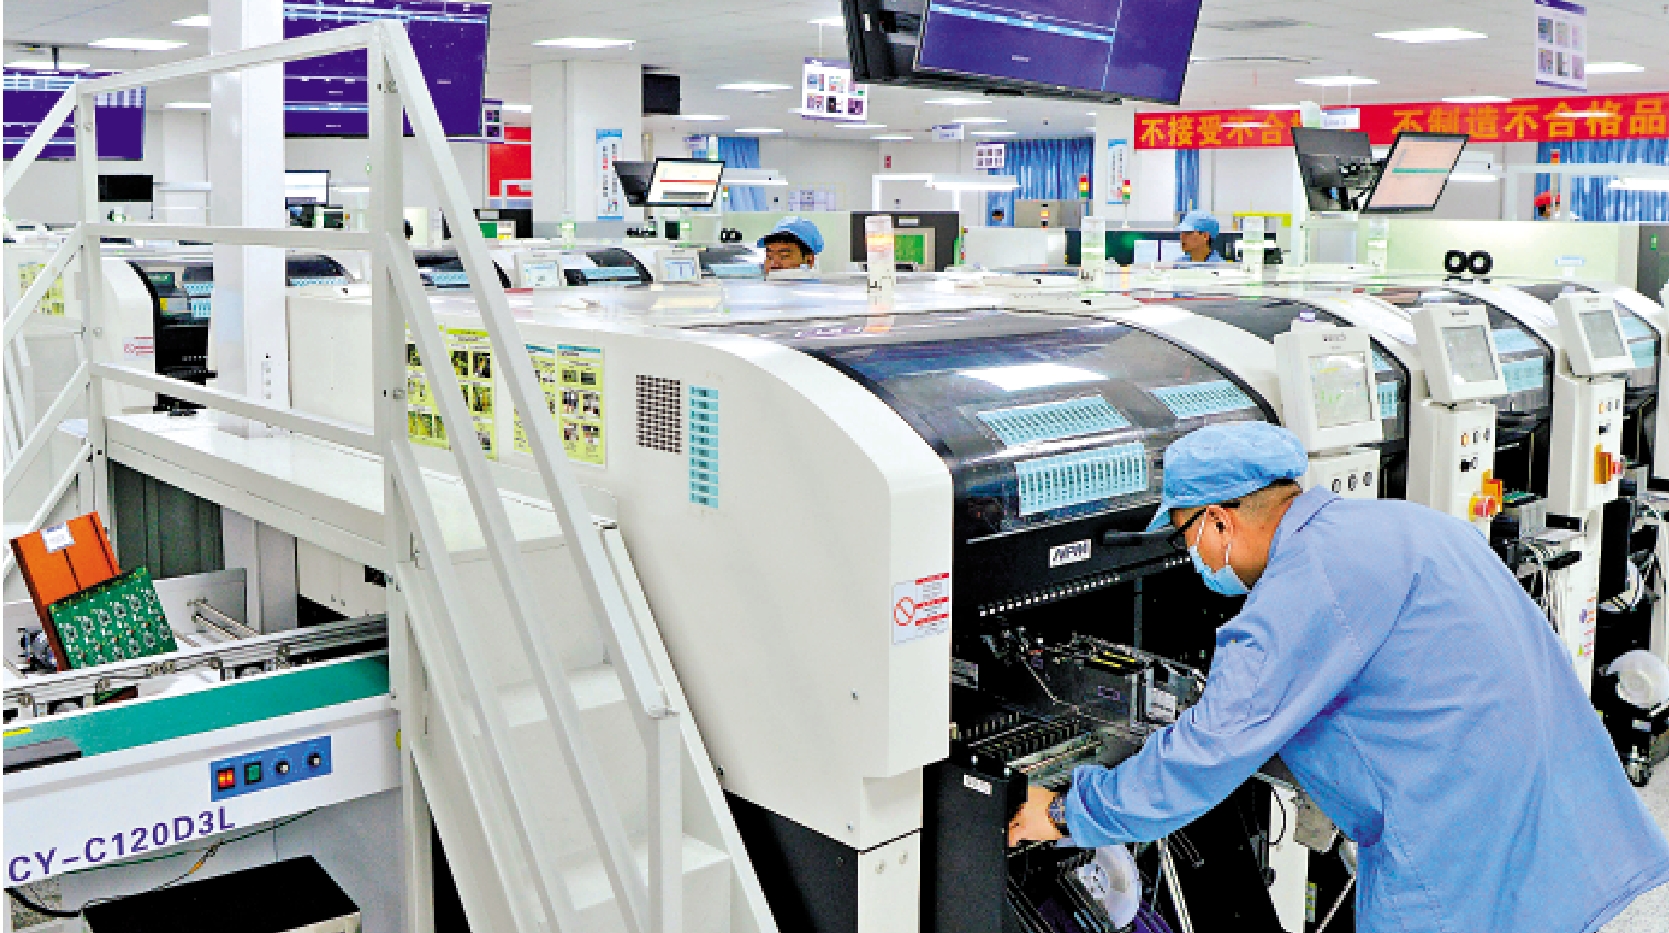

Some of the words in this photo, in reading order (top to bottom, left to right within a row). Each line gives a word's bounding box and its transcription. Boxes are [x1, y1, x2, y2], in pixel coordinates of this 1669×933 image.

[1391, 98, 1666, 139] 不制造不合格品
[8, 806, 236, 882] CY-C120D3L
